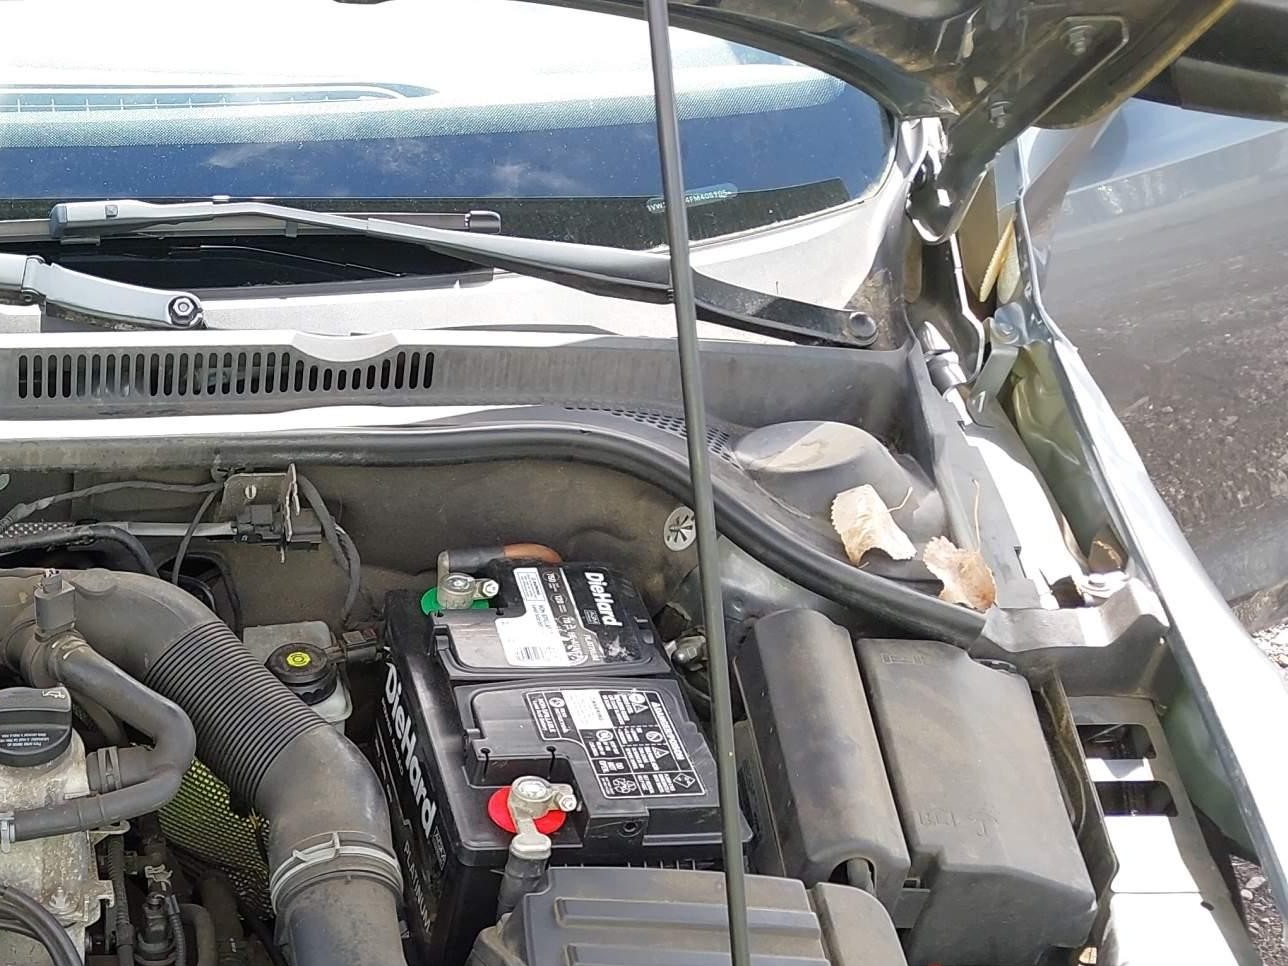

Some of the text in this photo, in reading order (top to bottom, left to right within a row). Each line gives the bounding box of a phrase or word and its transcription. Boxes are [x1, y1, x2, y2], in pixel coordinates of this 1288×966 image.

[584, 572, 624, 627] DieHard
[384, 662, 436, 840] DieHard
[403, 840, 432, 934] PLATINUM
